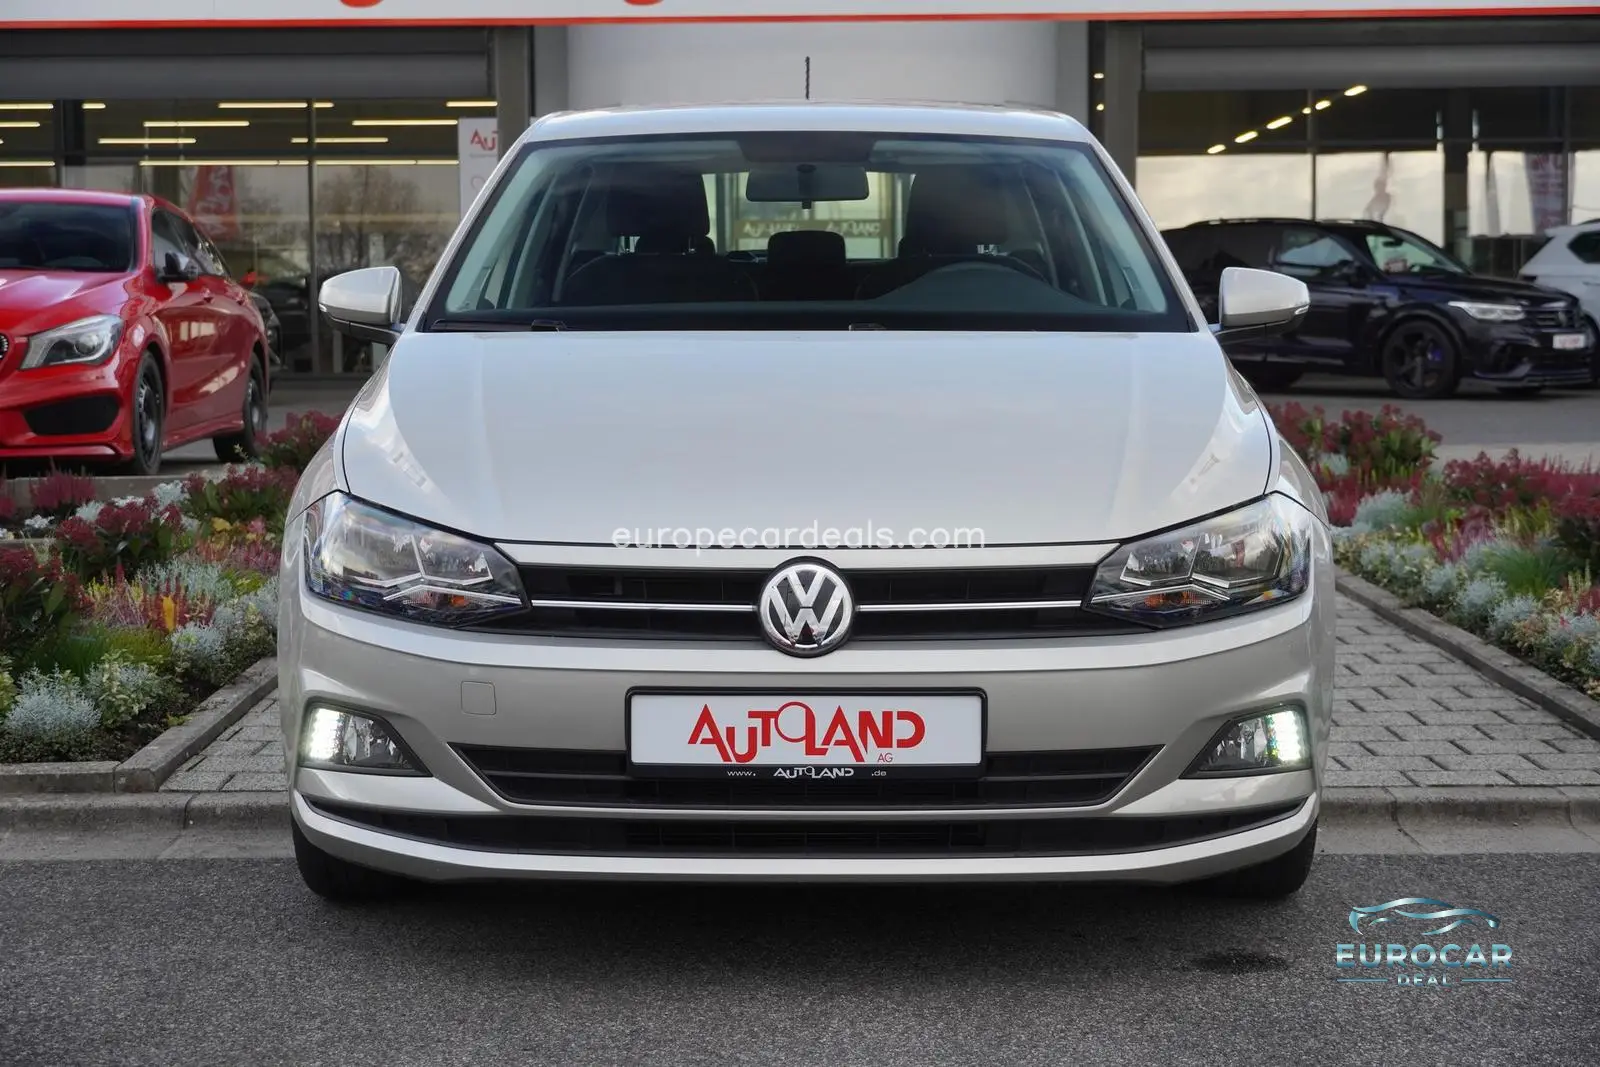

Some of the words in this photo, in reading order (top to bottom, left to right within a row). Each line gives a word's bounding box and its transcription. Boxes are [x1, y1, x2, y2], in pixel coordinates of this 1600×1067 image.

[767, 567, 845, 647] VW
[877, 753, 893, 764] AG
[871, 769, 887, 777] .de
